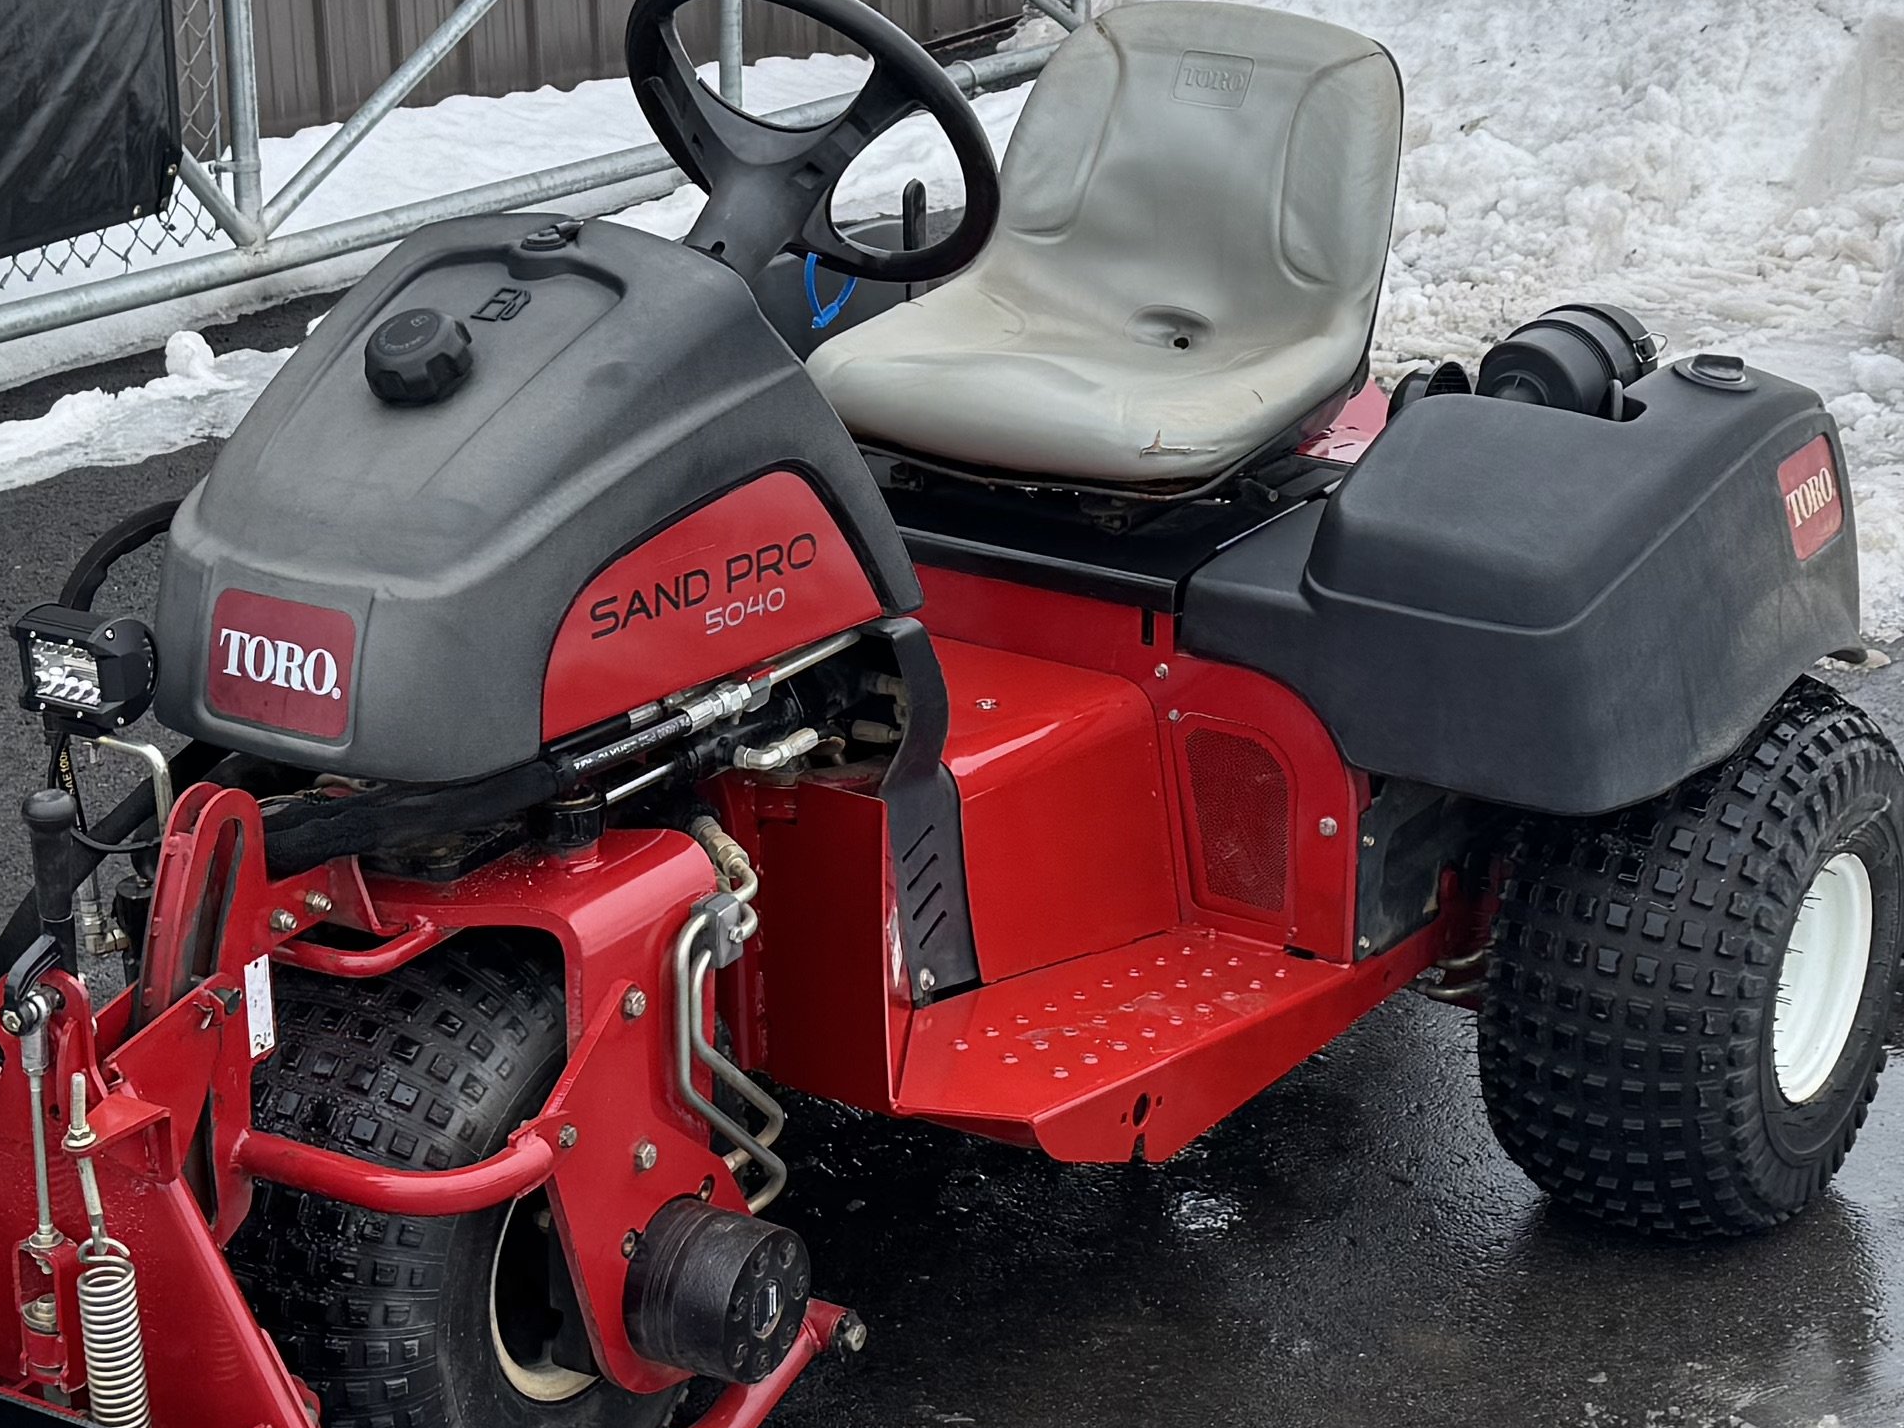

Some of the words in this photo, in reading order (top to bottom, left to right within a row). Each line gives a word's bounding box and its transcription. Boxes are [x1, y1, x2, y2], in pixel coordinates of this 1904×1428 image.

[1785, 467, 1833, 528] TORO
[589, 568, 711, 640] SAND
[726, 532, 817, 594] PRO
[705, 587, 786, 635] 5040
[219, 628, 338, 696] TORO
